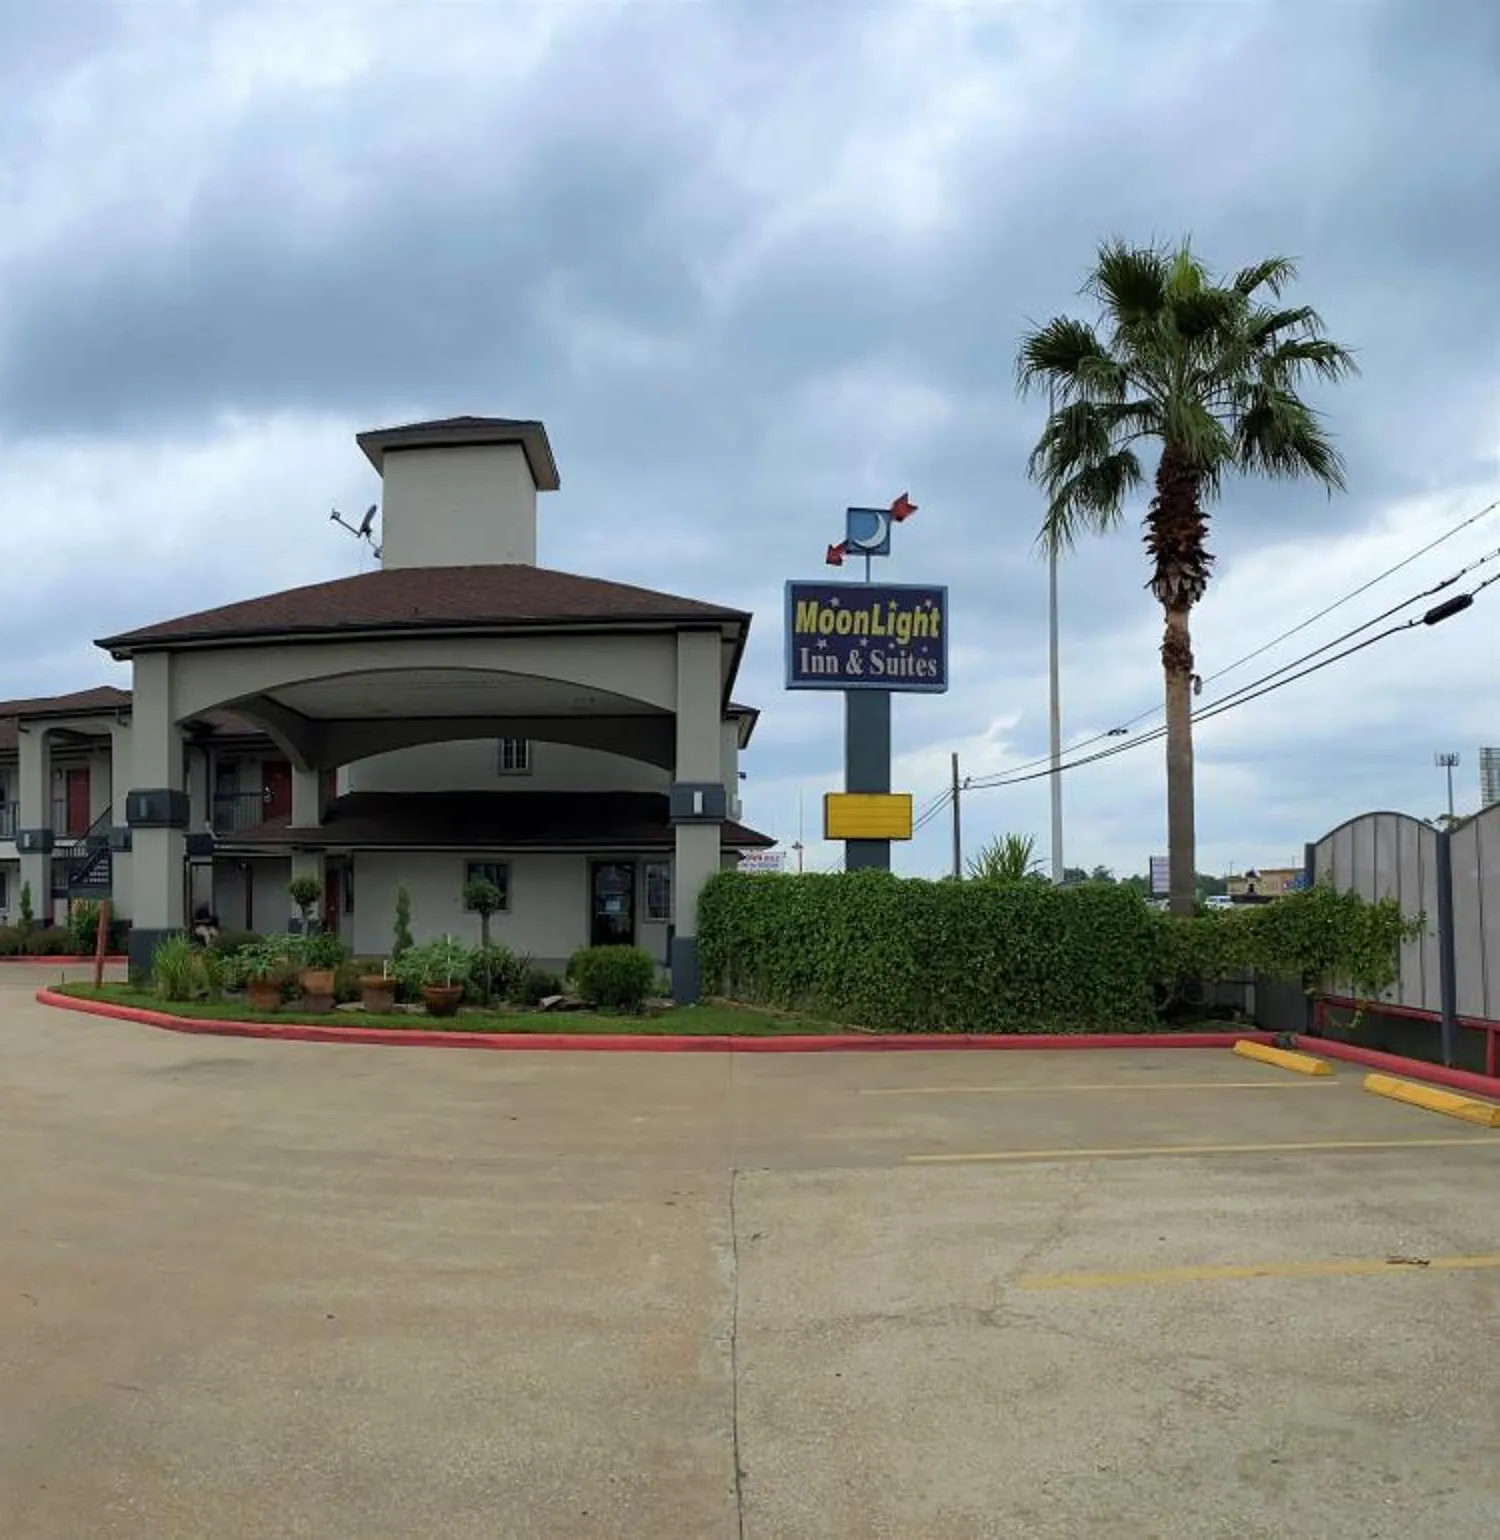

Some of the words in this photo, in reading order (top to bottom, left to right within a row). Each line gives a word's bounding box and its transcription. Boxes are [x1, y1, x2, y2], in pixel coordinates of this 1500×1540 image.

[795, 600, 940, 644] MoonLight
[800, 648, 839, 674] Inn
[846, 649, 864, 675] &
[869, 650, 937, 677] Suites
